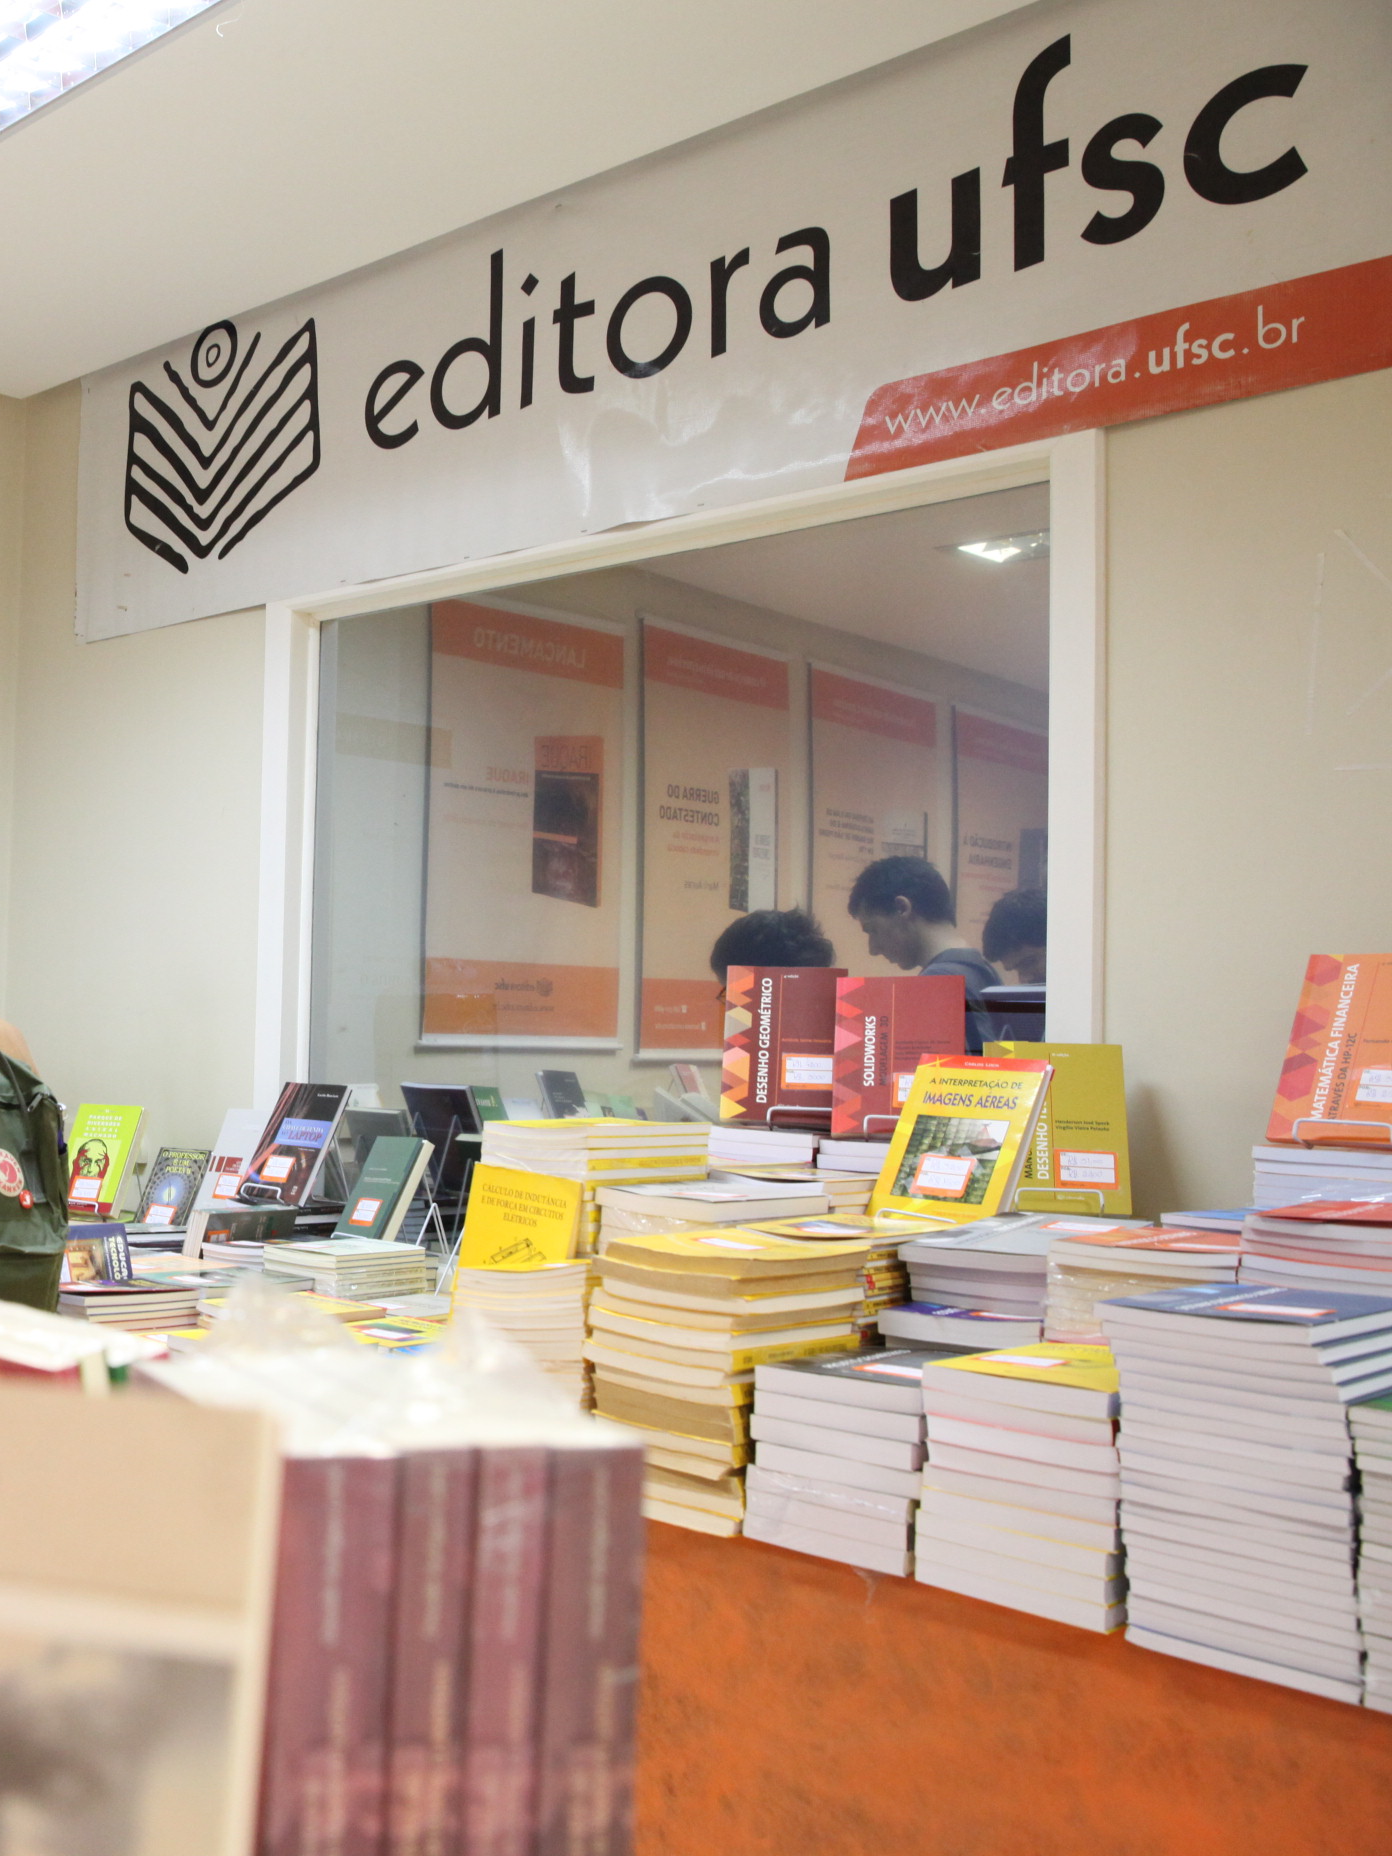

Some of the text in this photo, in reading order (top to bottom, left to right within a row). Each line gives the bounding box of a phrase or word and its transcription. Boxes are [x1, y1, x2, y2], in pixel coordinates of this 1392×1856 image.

[364, 33, 1309, 450] editora ufsc
[885, 305, 1305, 435] www.editora.ufsc.br
[756, 977, 773, 1104] DESENHO GEOMÉTRICO
[863, 1015, 877, 1087] SOLIDWORKS
[879, 1032, 889, 1086] MODELAGEM
[1310, 963, 1360, 1120] MATEMÁTICA FINANCEIRA
[1338, 1067, 1348, 1079] DA
[1343, 1032, 1357, 1065] HP-12C
[923, 1091, 974, 1107] IMAGENS
[929, 1077, 1024, 1090] A INTERPRETAÇÃO DE
[169, 1150, 206, 1160] PROFESSOR
[288, 1129, 323, 1142] LAPTOP
[1036, 1122, 1050, 1180] DESENHO
[514, 1189, 524, 1200] DE
[528, 1204, 564, 1221] CIRCUITOS
